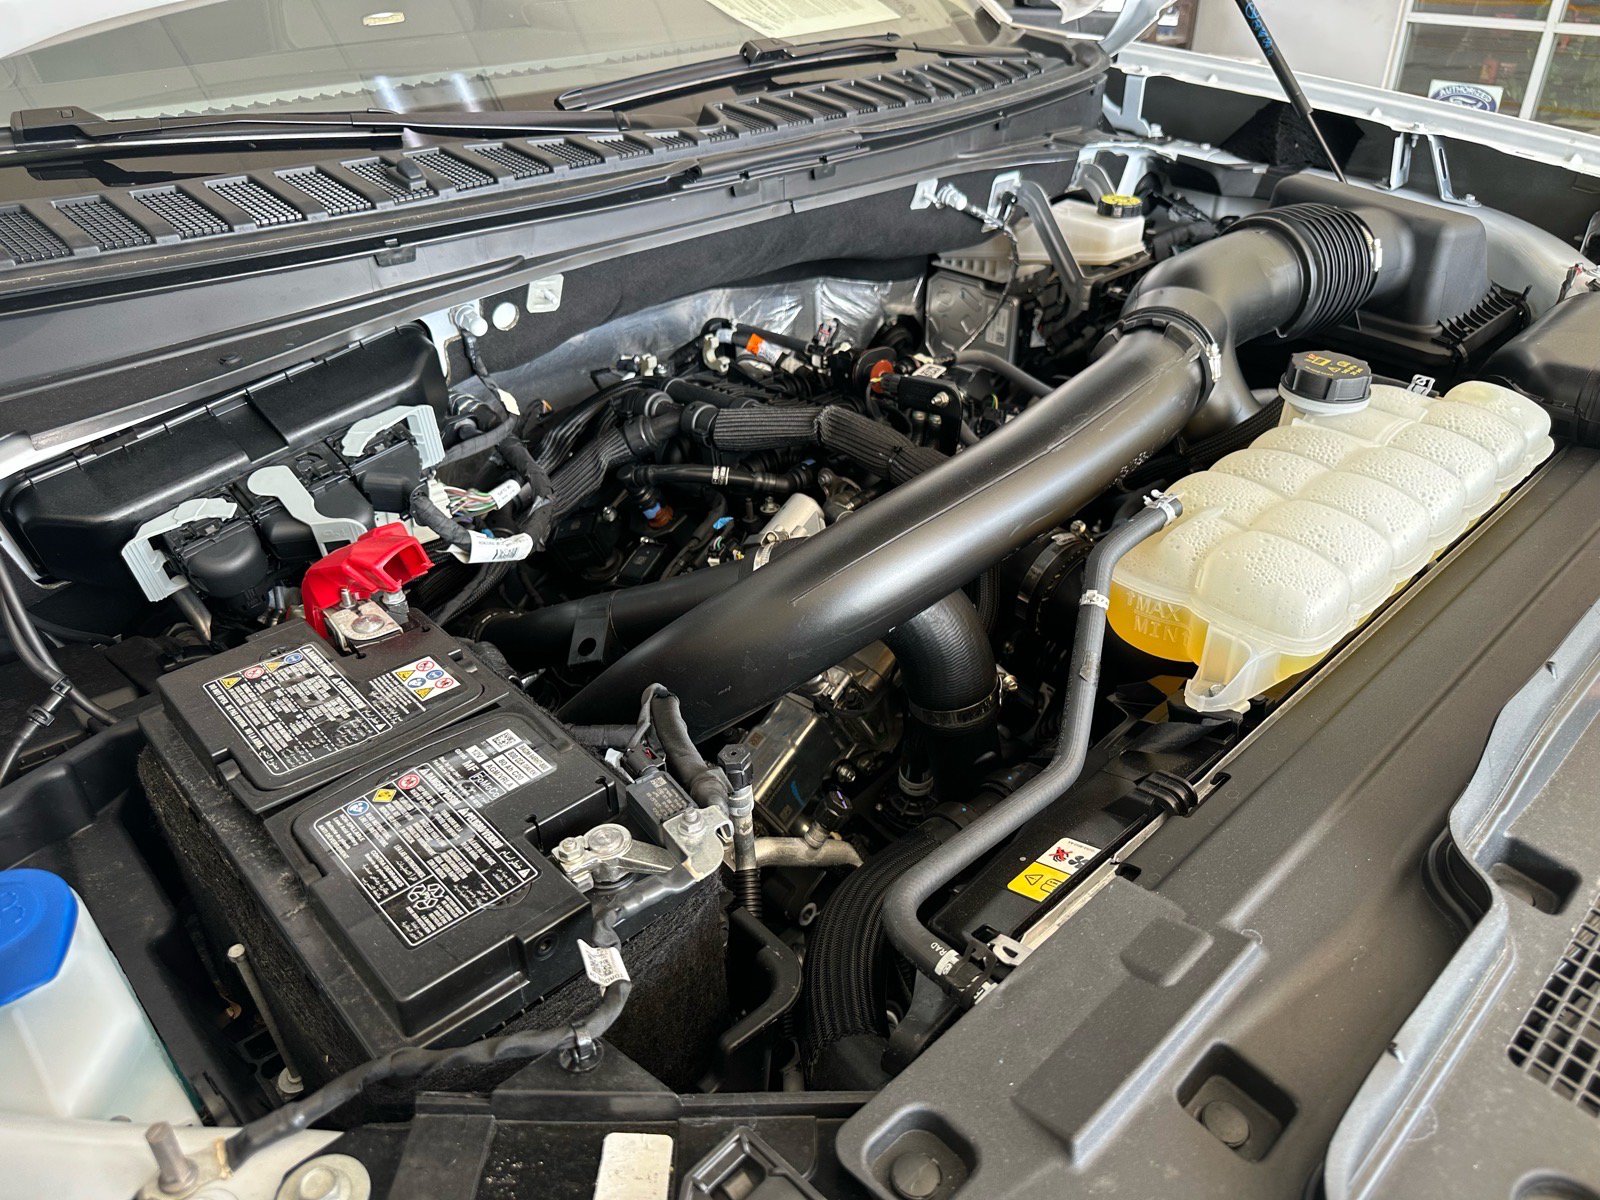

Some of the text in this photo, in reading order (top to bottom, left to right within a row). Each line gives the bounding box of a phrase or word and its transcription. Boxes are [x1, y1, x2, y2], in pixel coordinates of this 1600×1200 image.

[1439, 86, 1492, 103] AUTHORIZED
[1135, 594, 1181, 622] MAX
[1134, 614, 1179, 643] MIN
[470, 748, 484, 758] 12V
[460, 759, 480, 773] MF
[485, 763, 515, 787] AGM/VRLA
[510, 770, 524, 780] C20
[471, 773, 502, 798] FoMoCo
[930, 942, 947, 956] RAD
